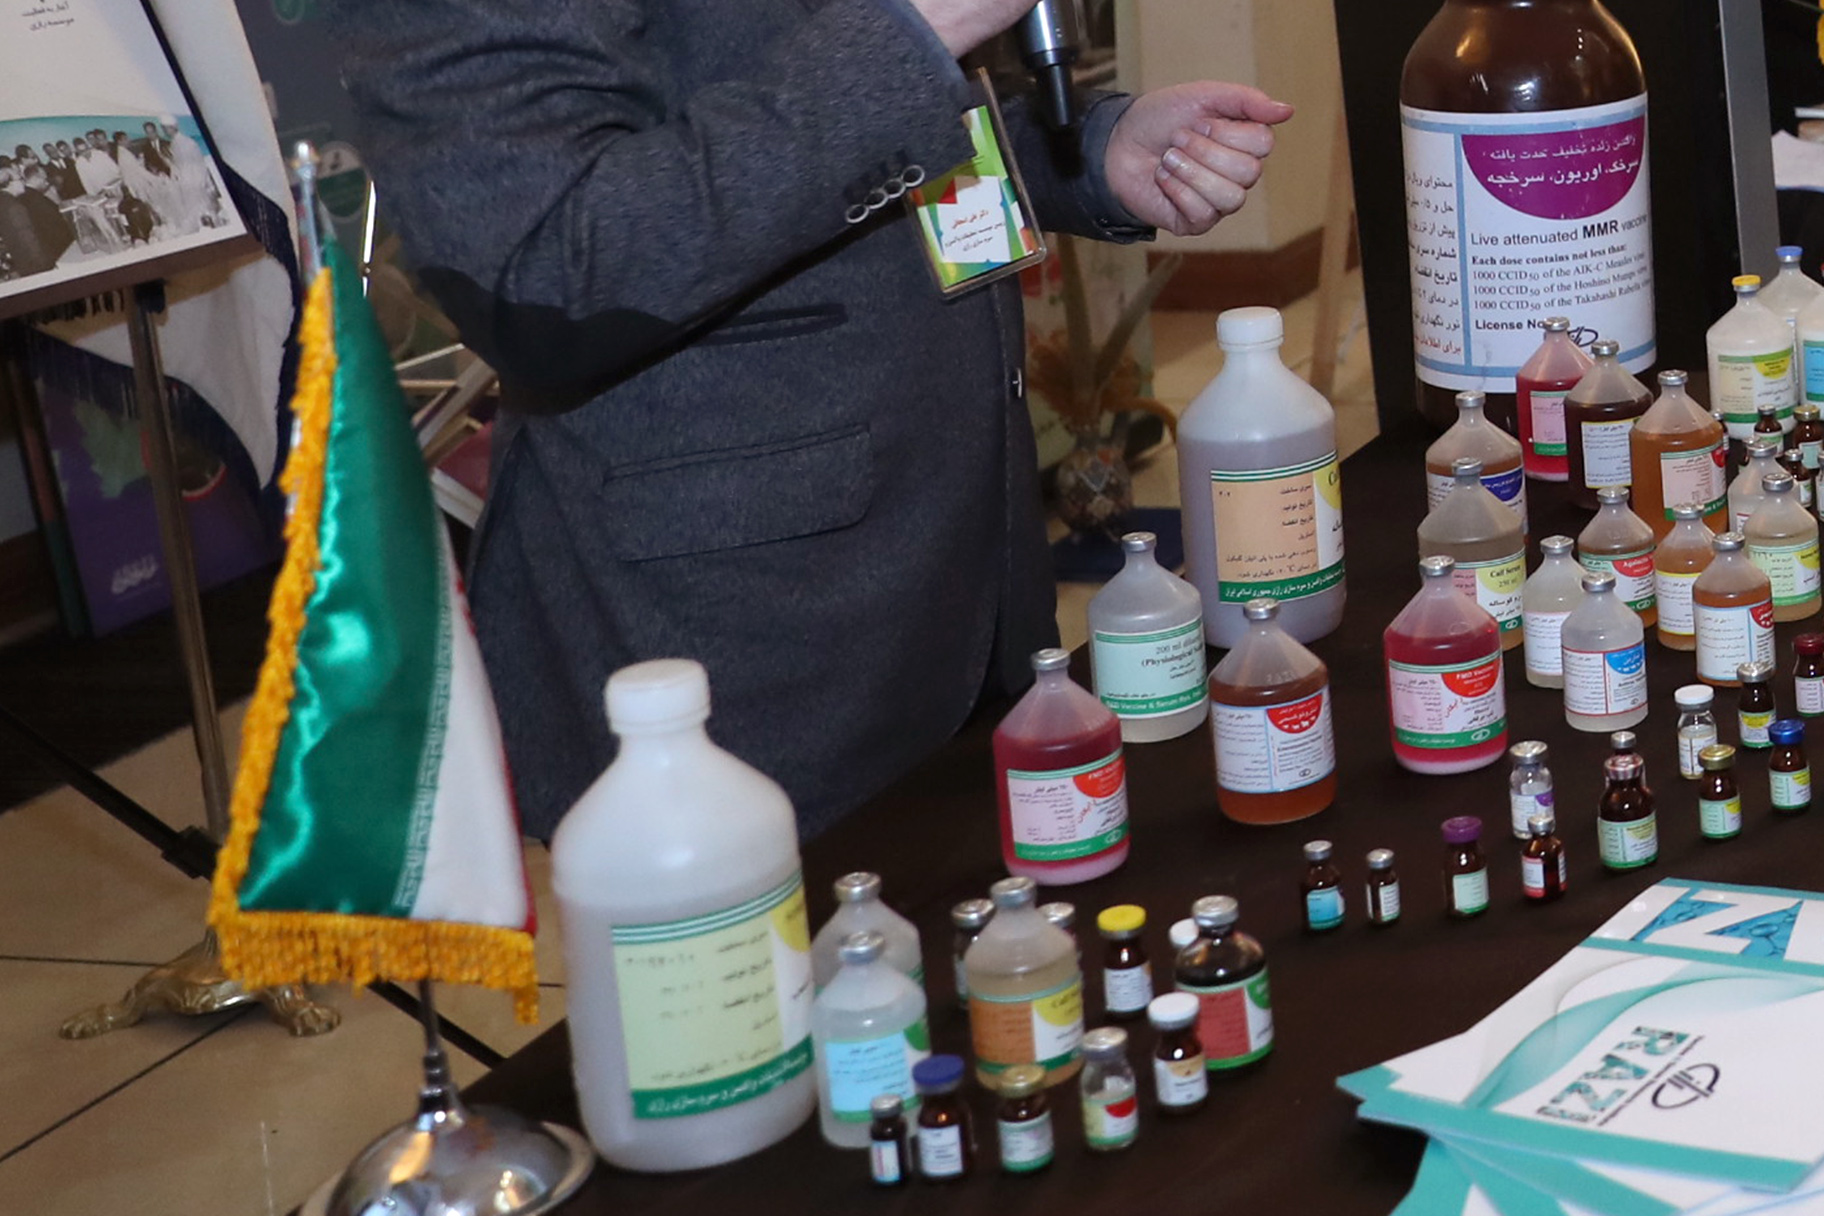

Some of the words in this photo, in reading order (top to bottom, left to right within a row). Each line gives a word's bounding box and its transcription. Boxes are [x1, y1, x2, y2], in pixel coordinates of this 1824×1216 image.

[1471, 232, 1499, 246] Live
[1503, 229, 1578, 246] attenuated
[1582, 219, 1619, 239] MMR
[1472, 256, 1497, 265] Each
[1500, 256, 1523, 265] dose
[1526, 253, 1569, 264] contains
[1572, 251, 1588, 260] not
[1590, 248, 1606, 258] less
[1433, 271, 1458, 285] تاریخ
[1472, 270, 1496, 280] 1000
[1543, 270, 1554, 279] of
[1556, 268, 1571, 277] the
[1473, 286, 1496, 295] 1000
[1543, 284, 1555, 293] of
[1556, 282, 1571, 291] the
[1474, 301, 1497, 310] 1000
[1544, 298, 1555, 308] of
[1557, 297, 1573, 306] the
[1475, 320, 1523, 330] License
[1536, 1026, 1690, 1123] RAZI
